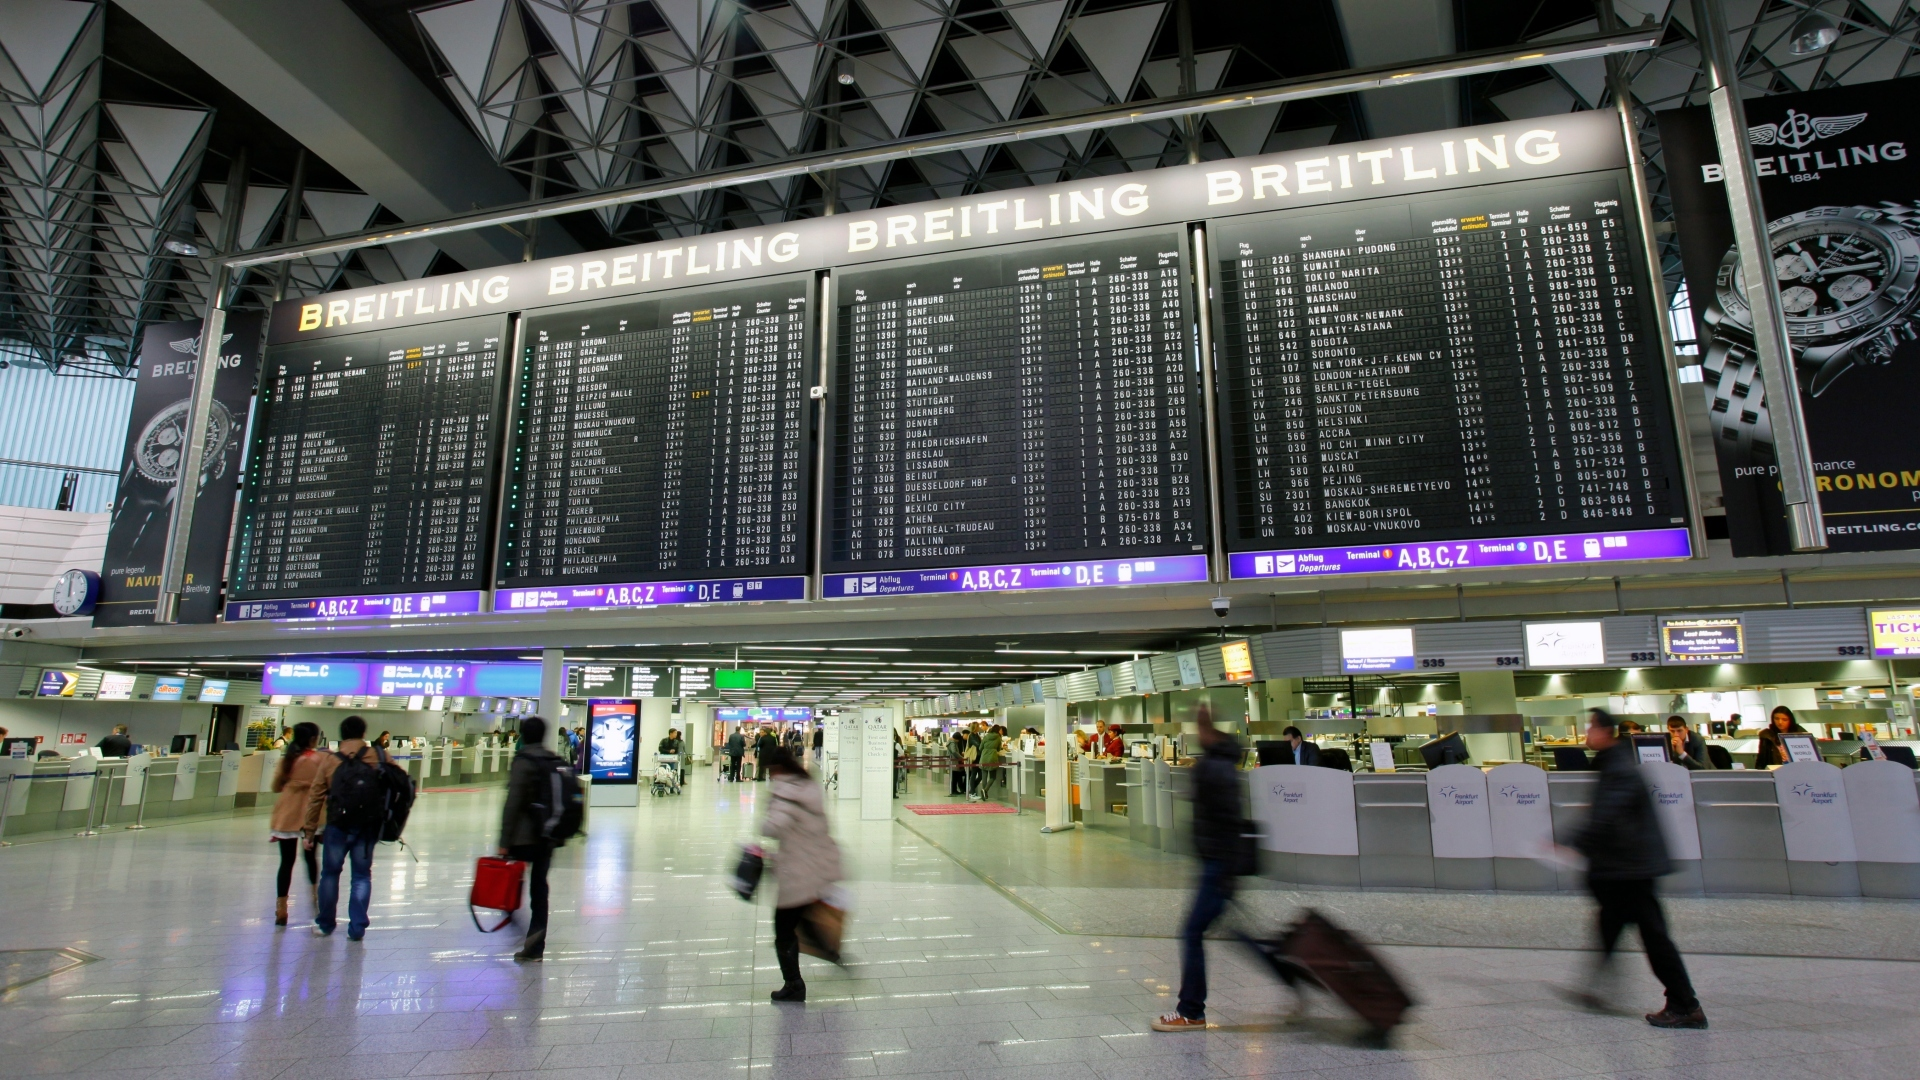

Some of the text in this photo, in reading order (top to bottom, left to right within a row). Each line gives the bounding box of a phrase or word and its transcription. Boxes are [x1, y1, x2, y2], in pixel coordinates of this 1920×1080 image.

[1206, 129, 1562, 206] BREITLING
[1701, 142, 1907, 183] BEITLING
[1789, 172, 1820, 183] 1884
[1549, 205, 1571, 213] Schalter
[1594, 200, 1618, 208] Flugsteig
[847, 183, 1150, 253] BREITLING
[1460, 215, 1485, 223] erwartet
[1488, 212, 1510, 220] Terminal
[1551, 212, 1571, 220] Counter
[1461, 222, 1488, 231] estimated
[1491, 219, 1512, 227] Terminal
[1272, 255, 1290, 264] 220
[1303, 248, 1351, 261] SHANGHAI
[1358, 243, 1396, 255] PUDONG
[1500, 231, 1506, 239] 2
[1520, 229, 1527, 237] D
[1540, 222, 1588, 235] 854-859
[548, 232, 800, 296] BREITLING
[1303, 260, 1341, 272] KUWAIT
[1305, 267, 1380, 282] TOKIO NARITA
[907, 268, 1178, 307] HAMBURG 260-338 A16
[1305, 281, 1349, 293] ORLANDO
[298, 275, 510, 332] BREITLING
[1306, 291, 1357, 304] WARSCHAU
[1307, 304, 1339, 315] AMMAN
[907, 314, 954, 327] BARCELONA
[1308, 309, 1404, 326] NEW YORK-NEWARK
[581, 316, 779, 347] VERONA 260-338
[1309, 321, 1392, 337] ALMATY-ASTANA
[1311, 337, 1349, 348] BOGOTA
[907, 344, 954, 357] KOELN HBF
[152, 354, 242, 378] BREITNG
[1313, 351, 1443, 370] NEW YORK-J.F.KENN CY
[1314, 365, 1410, 381] LONDON-HEATHROW
[310, 388, 339, 399] SINGAPUR
[576, 389, 633, 402] LEIPZIG HALLE
[1316, 388, 1420, 404] SANKT PETERSBURG
[906, 395, 954, 408] STUTTGART
[906, 406, 955, 418] NUERNBERG
[1316, 404, 1362, 416] HOUSTON
[1317, 415, 1368, 427] HELSINKI
[906, 435, 988, 449] FRIEDRICHSHAFEN
[1320, 434, 1425, 450] HO CHI MINH CITY
[300, 454, 348, 466] SAN FRANCISCO
[906, 460, 949, 471] LISSABON
[569, 466, 622, 477] BERLIN-TEGEL
[1735, 466, 1765, 478] pure
[1324, 480, 1451, 498] MOSKAU-SHEREMETYEVO
[336, 505, 360, 514] GAULLE
[905, 501, 966, 513] MEXICO CITY
[1325, 498, 1371, 510] BANGKOK
[566, 515, 620, 526] PHILADELPHIA
[1326, 508, 1412, 522] KIEW-BORISPOL
[905, 522, 995, 535] MONTREAL-TRUDEAU
[1327, 519, 1421, 534] MOSKAU-VNUKOVO
[287, 553, 321, 562] AMSTERDAM
[1297, 553, 1324, 564] Abflug
[1346, 539, 1567, 570] Terminal A,B,C,Z Terminal D,E
[111, 565, 145, 576] pure legend
[562, 565, 599, 575] MUENCHEN
[1299, 562, 1342, 574] Departures
[126, 573, 194, 587] NAVITR
[879, 575, 901, 585] Abflug
[919, 565, 1103, 591] Terminal A,B,C,Z Terminal D,E
[185, 584, 210, 593] Breitling
[572, 583, 721, 605] Terminal A,B,C,Z Terminal D,E
[879, 584, 915, 594] Departures
[539, 590, 558, 600] Abflug
[263, 603, 279, 611] Abflug
[317, 599, 359, 616] A,B,C,Z
[363, 598, 384, 606] Terminal
[392, 597, 413, 614] D,E
[539, 598, 568, 607] Departures
[1838, 645, 1864, 656] 532
[1422, 659, 1445, 667] 535
[1496, 656, 1520, 666] 534
[1631, 652, 1655, 662] 533
[320, 664, 329, 677] C
